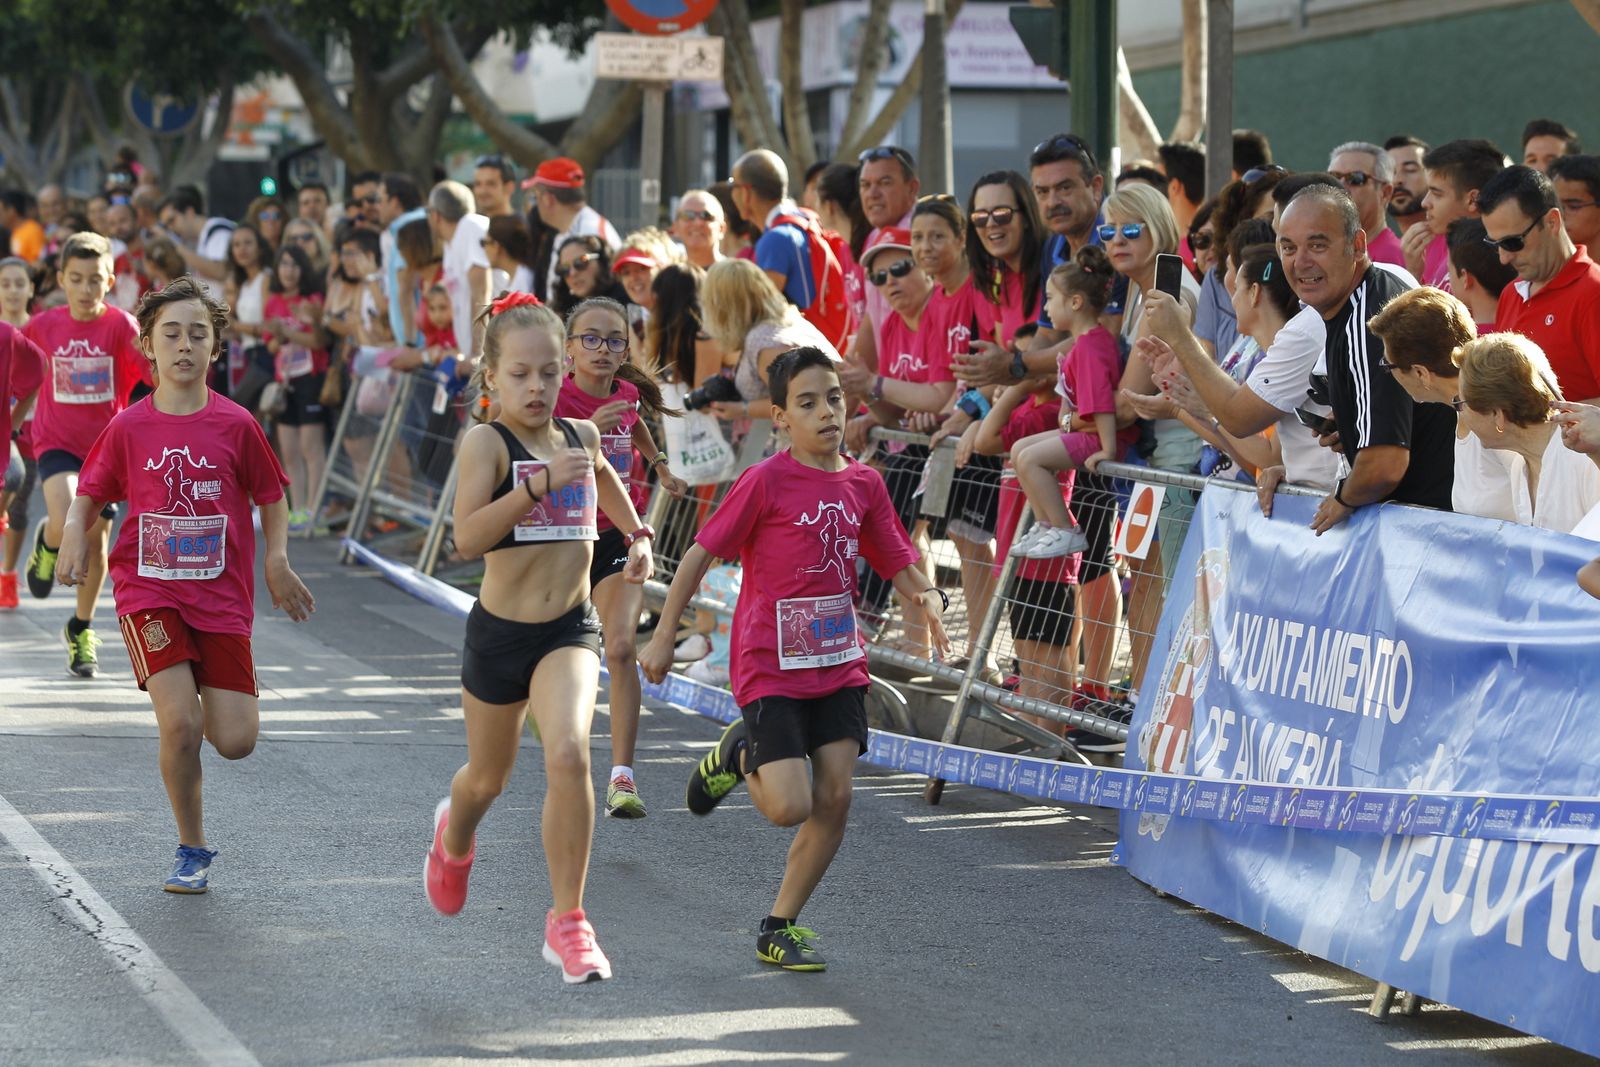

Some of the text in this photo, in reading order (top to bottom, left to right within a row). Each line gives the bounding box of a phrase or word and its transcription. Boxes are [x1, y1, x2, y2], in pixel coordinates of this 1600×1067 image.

[165, 535, 221, 555] 1657
[1218, 610, 1413, 725] AYUNTAMIENTO
[1195, 705, 1236, 779] DE
